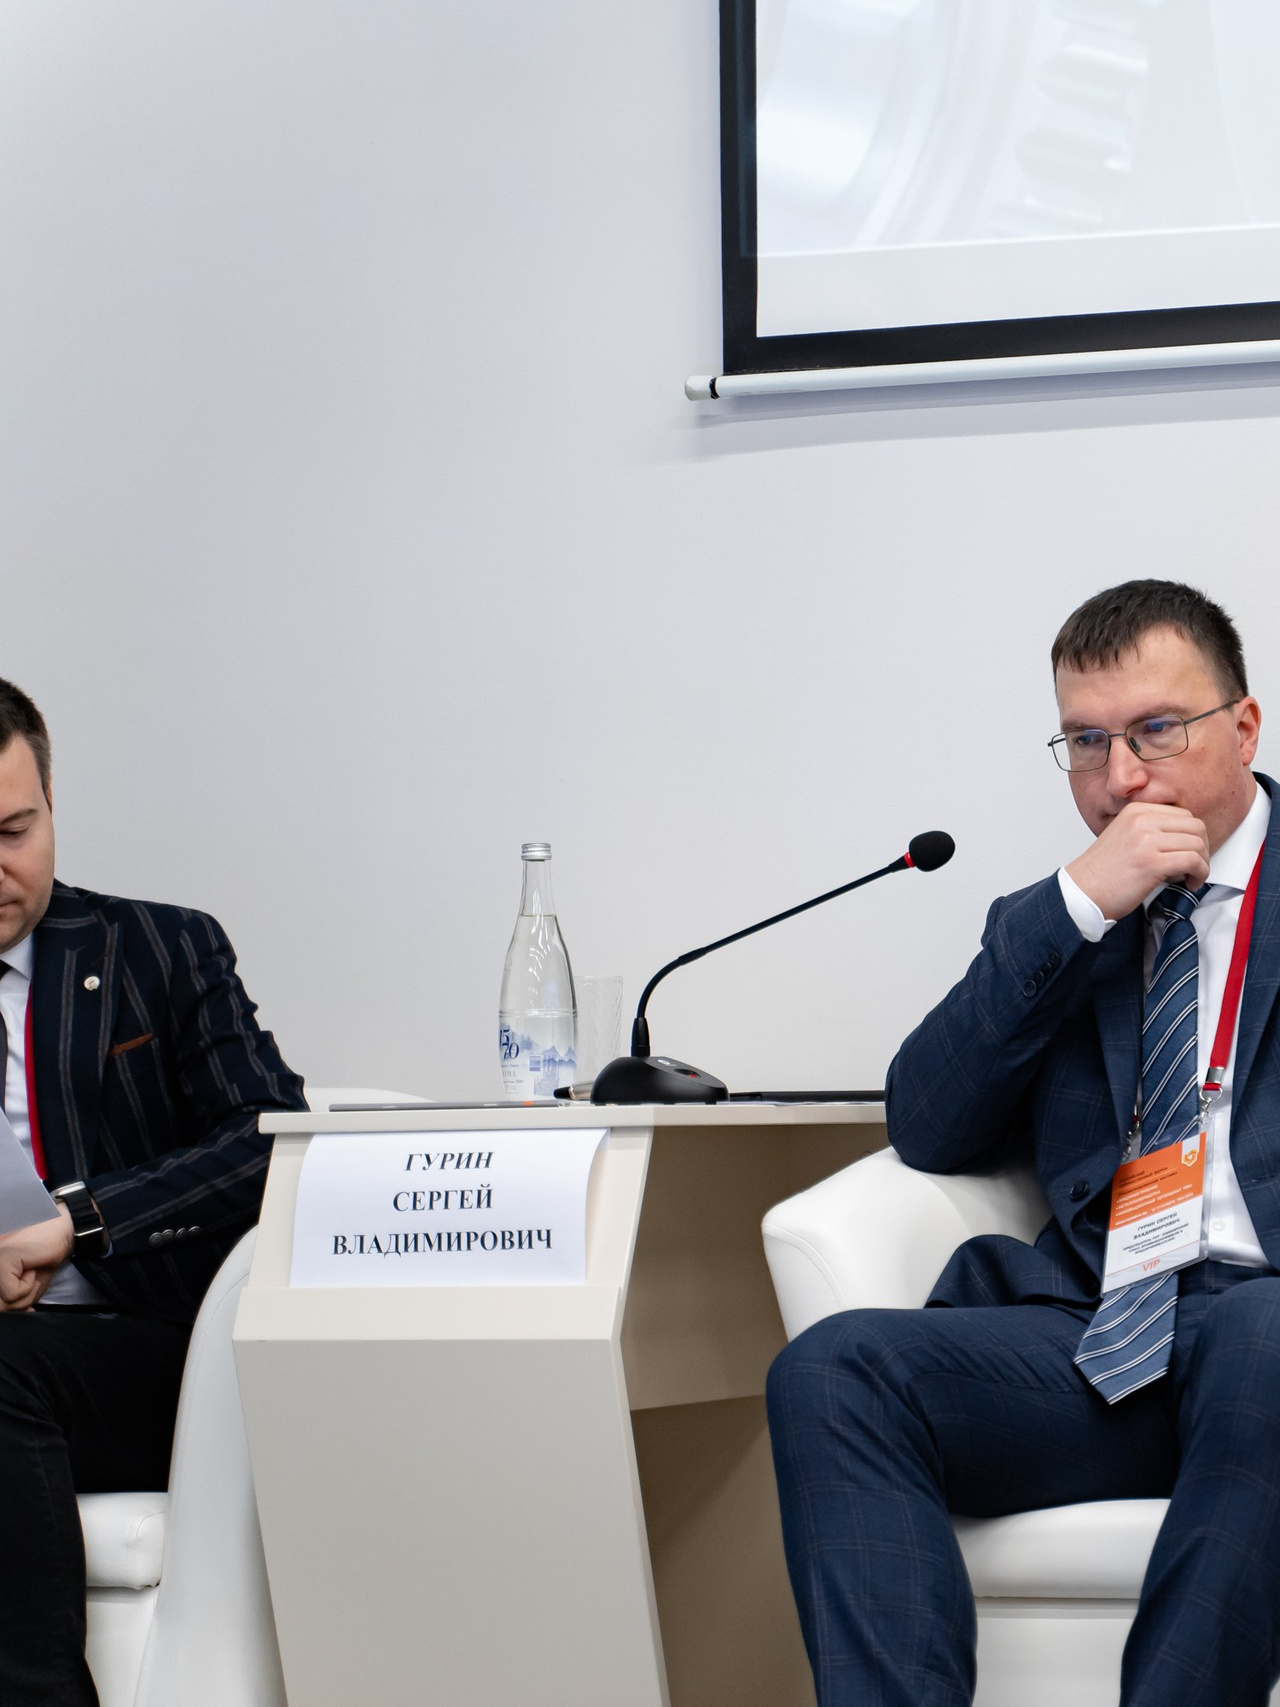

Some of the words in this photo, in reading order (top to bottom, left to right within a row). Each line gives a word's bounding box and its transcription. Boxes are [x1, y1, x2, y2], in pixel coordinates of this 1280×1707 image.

[404, 1151, 495, 1172] ГУРИН
[393, 1183, 494, 1212] СЕРГЕЙ
[332, 1228, 553, 1258] ВЛАДИМИРОВИЧ
[1142, 1258, 1161, 1272] VIP
